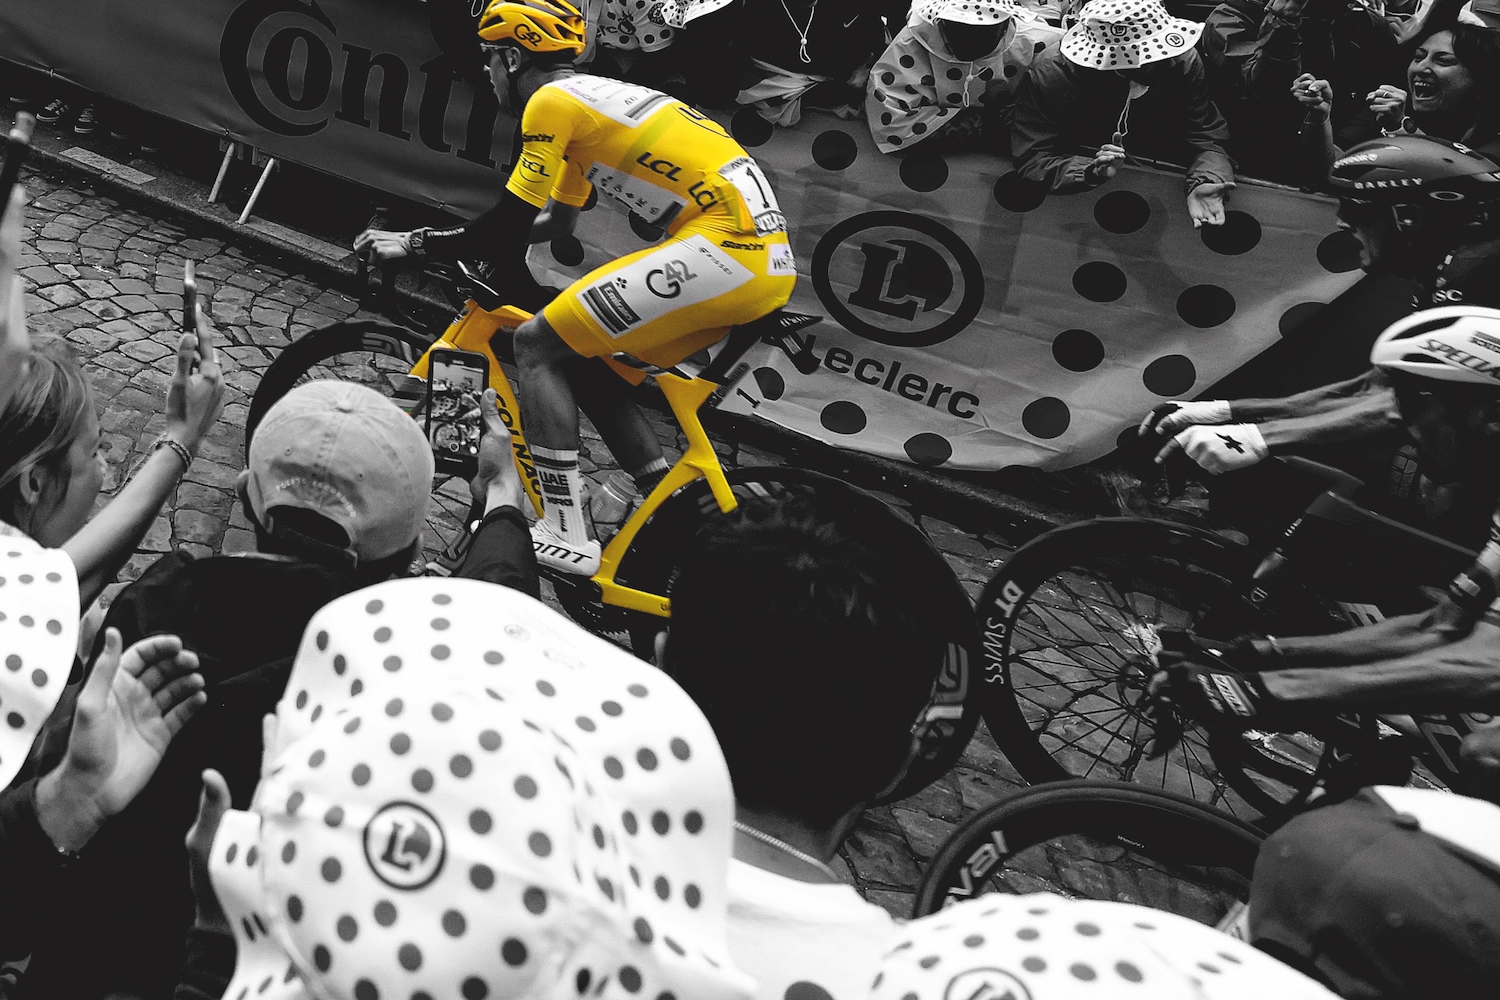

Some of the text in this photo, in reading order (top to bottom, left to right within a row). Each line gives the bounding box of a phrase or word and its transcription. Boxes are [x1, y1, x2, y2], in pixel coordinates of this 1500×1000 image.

[514, 23, 542, 46] G42
[637, 151, 684, 183] LCL
[746, 166, 770, 209] 1
[1354, 177, 1422, 190] OAKLEY
[646, 260, 698, 299] G42
[539, 470, 568, 486] UAE
[982, 579, 1026, 685] DT SWISS
